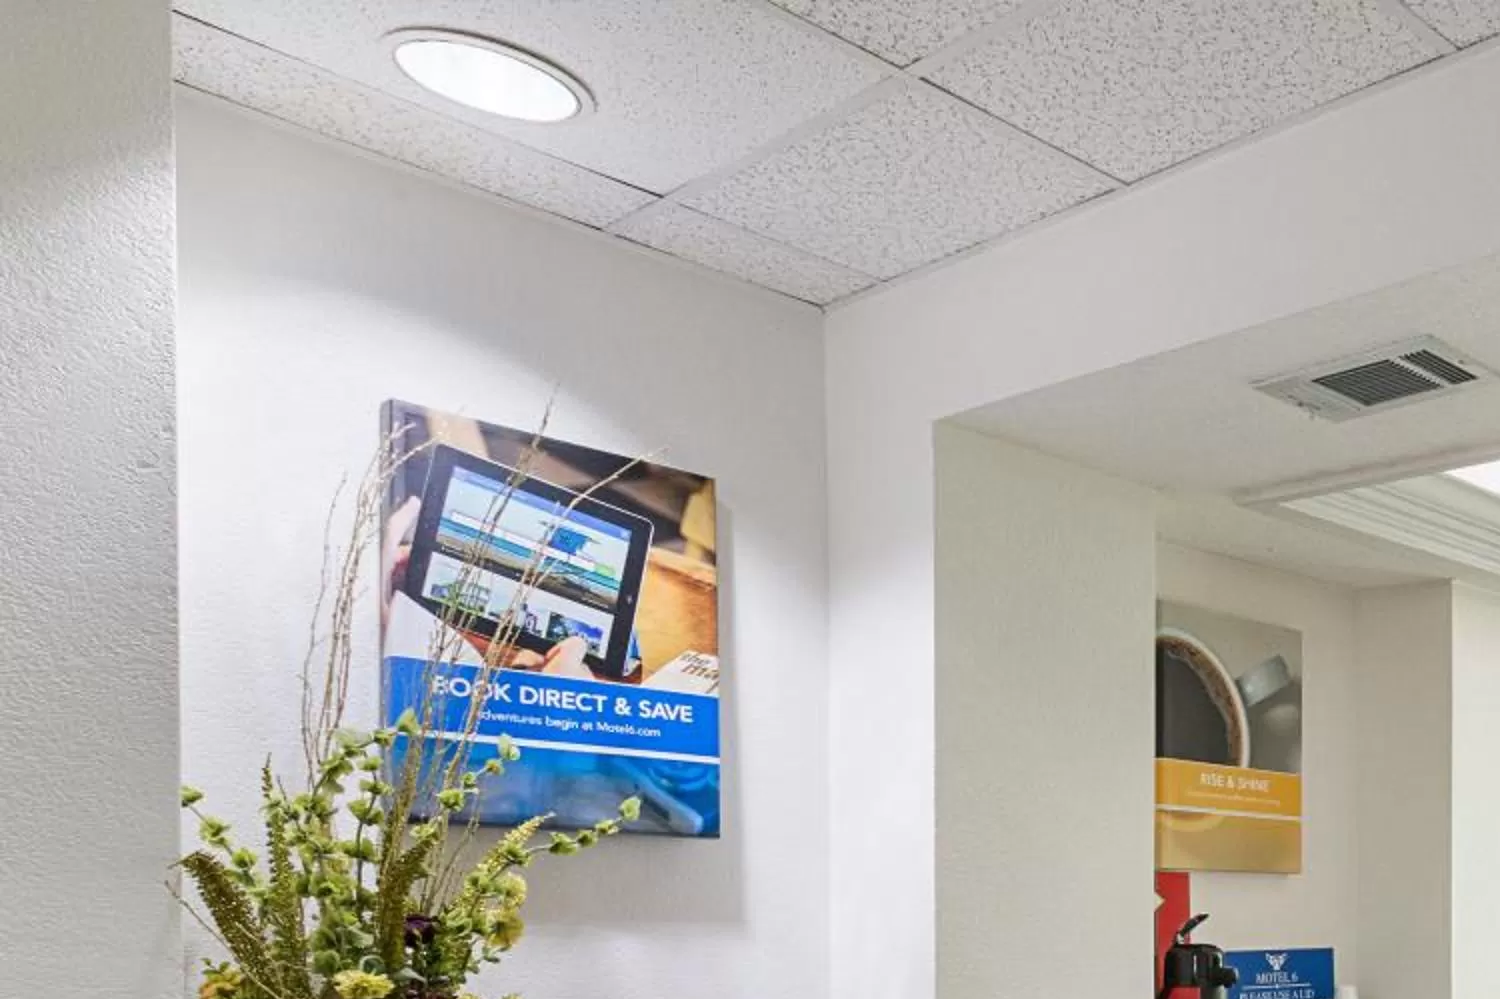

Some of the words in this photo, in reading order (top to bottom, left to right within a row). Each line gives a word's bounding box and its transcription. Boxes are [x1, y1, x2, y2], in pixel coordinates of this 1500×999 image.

[432, 675, 512, 703] BOOK
[519, 685, 608, 712] DIRECT
[614, 697, 632, 716] &
[639, 699, 693, 722] SAVE
[479, 709, 542, 725] dventures
[545, 715, 579, 731] begin
[582, 721, 593, 731] at
[1255, 971, 1291, 985] MOTEL
